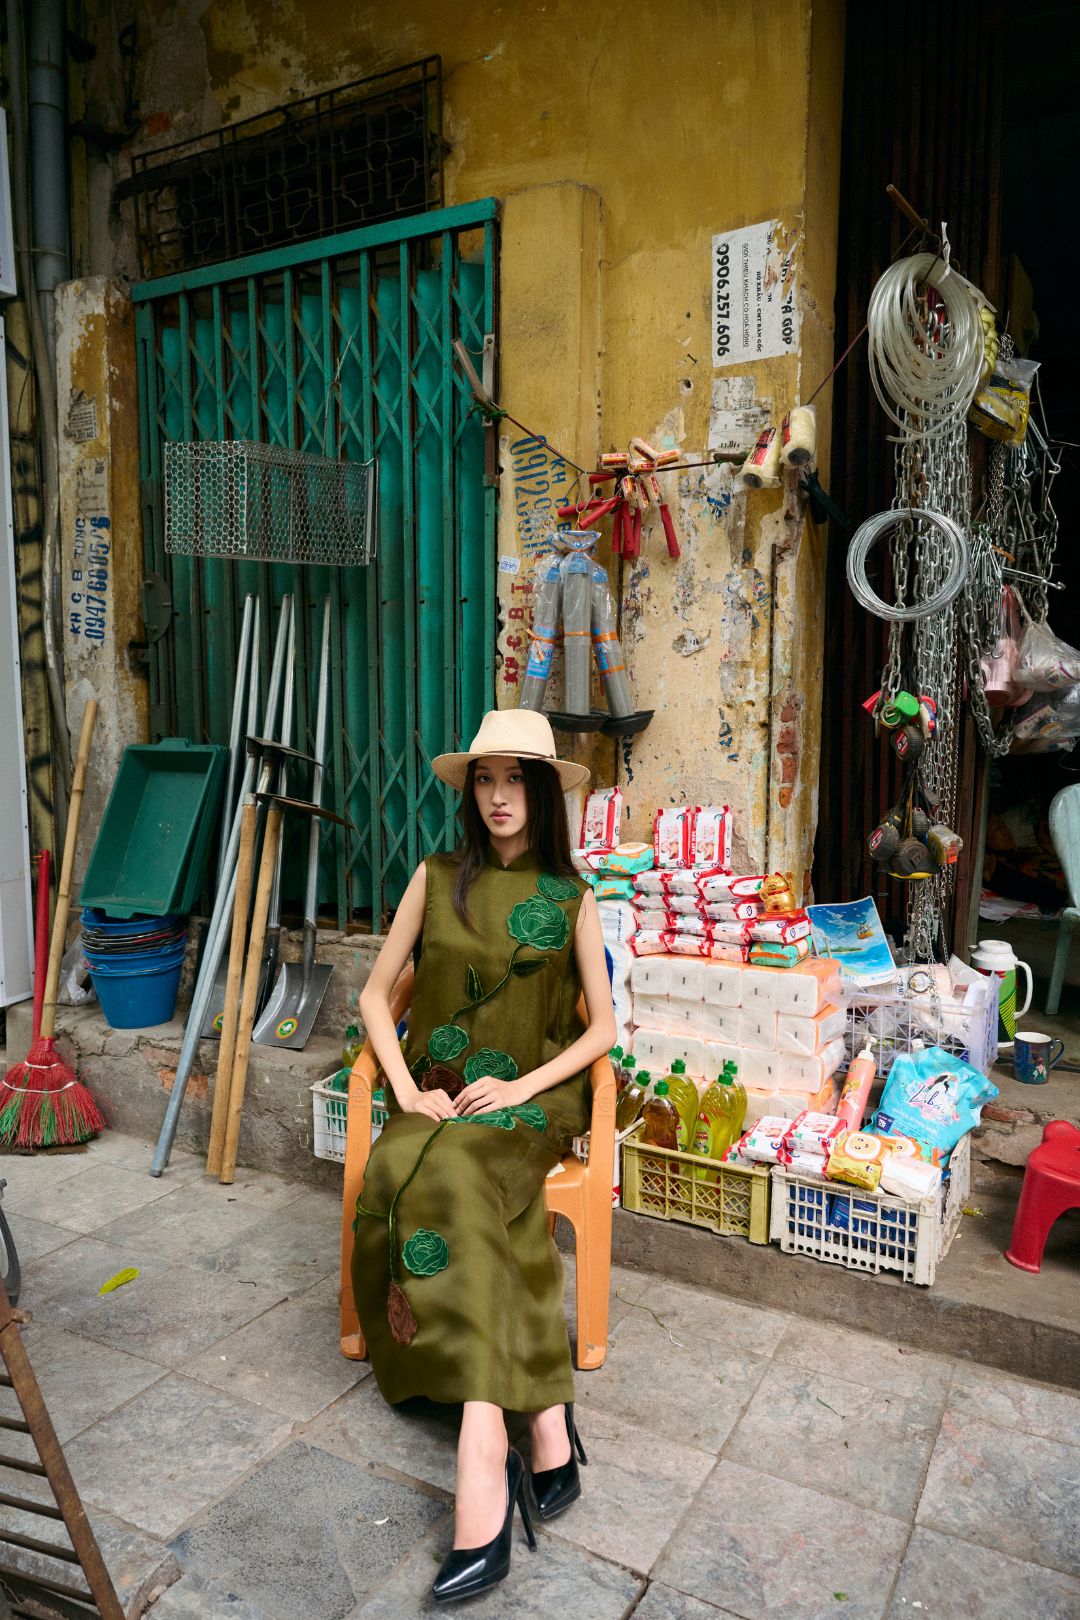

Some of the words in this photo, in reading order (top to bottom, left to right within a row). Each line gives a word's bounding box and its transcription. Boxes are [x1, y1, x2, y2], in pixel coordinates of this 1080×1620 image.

[716, 243, 730, 357] 0906.257.606
[71, 569, 83, 581] B
[508, 608, 524, 620] B
[70, 612, 82, 635] KH
